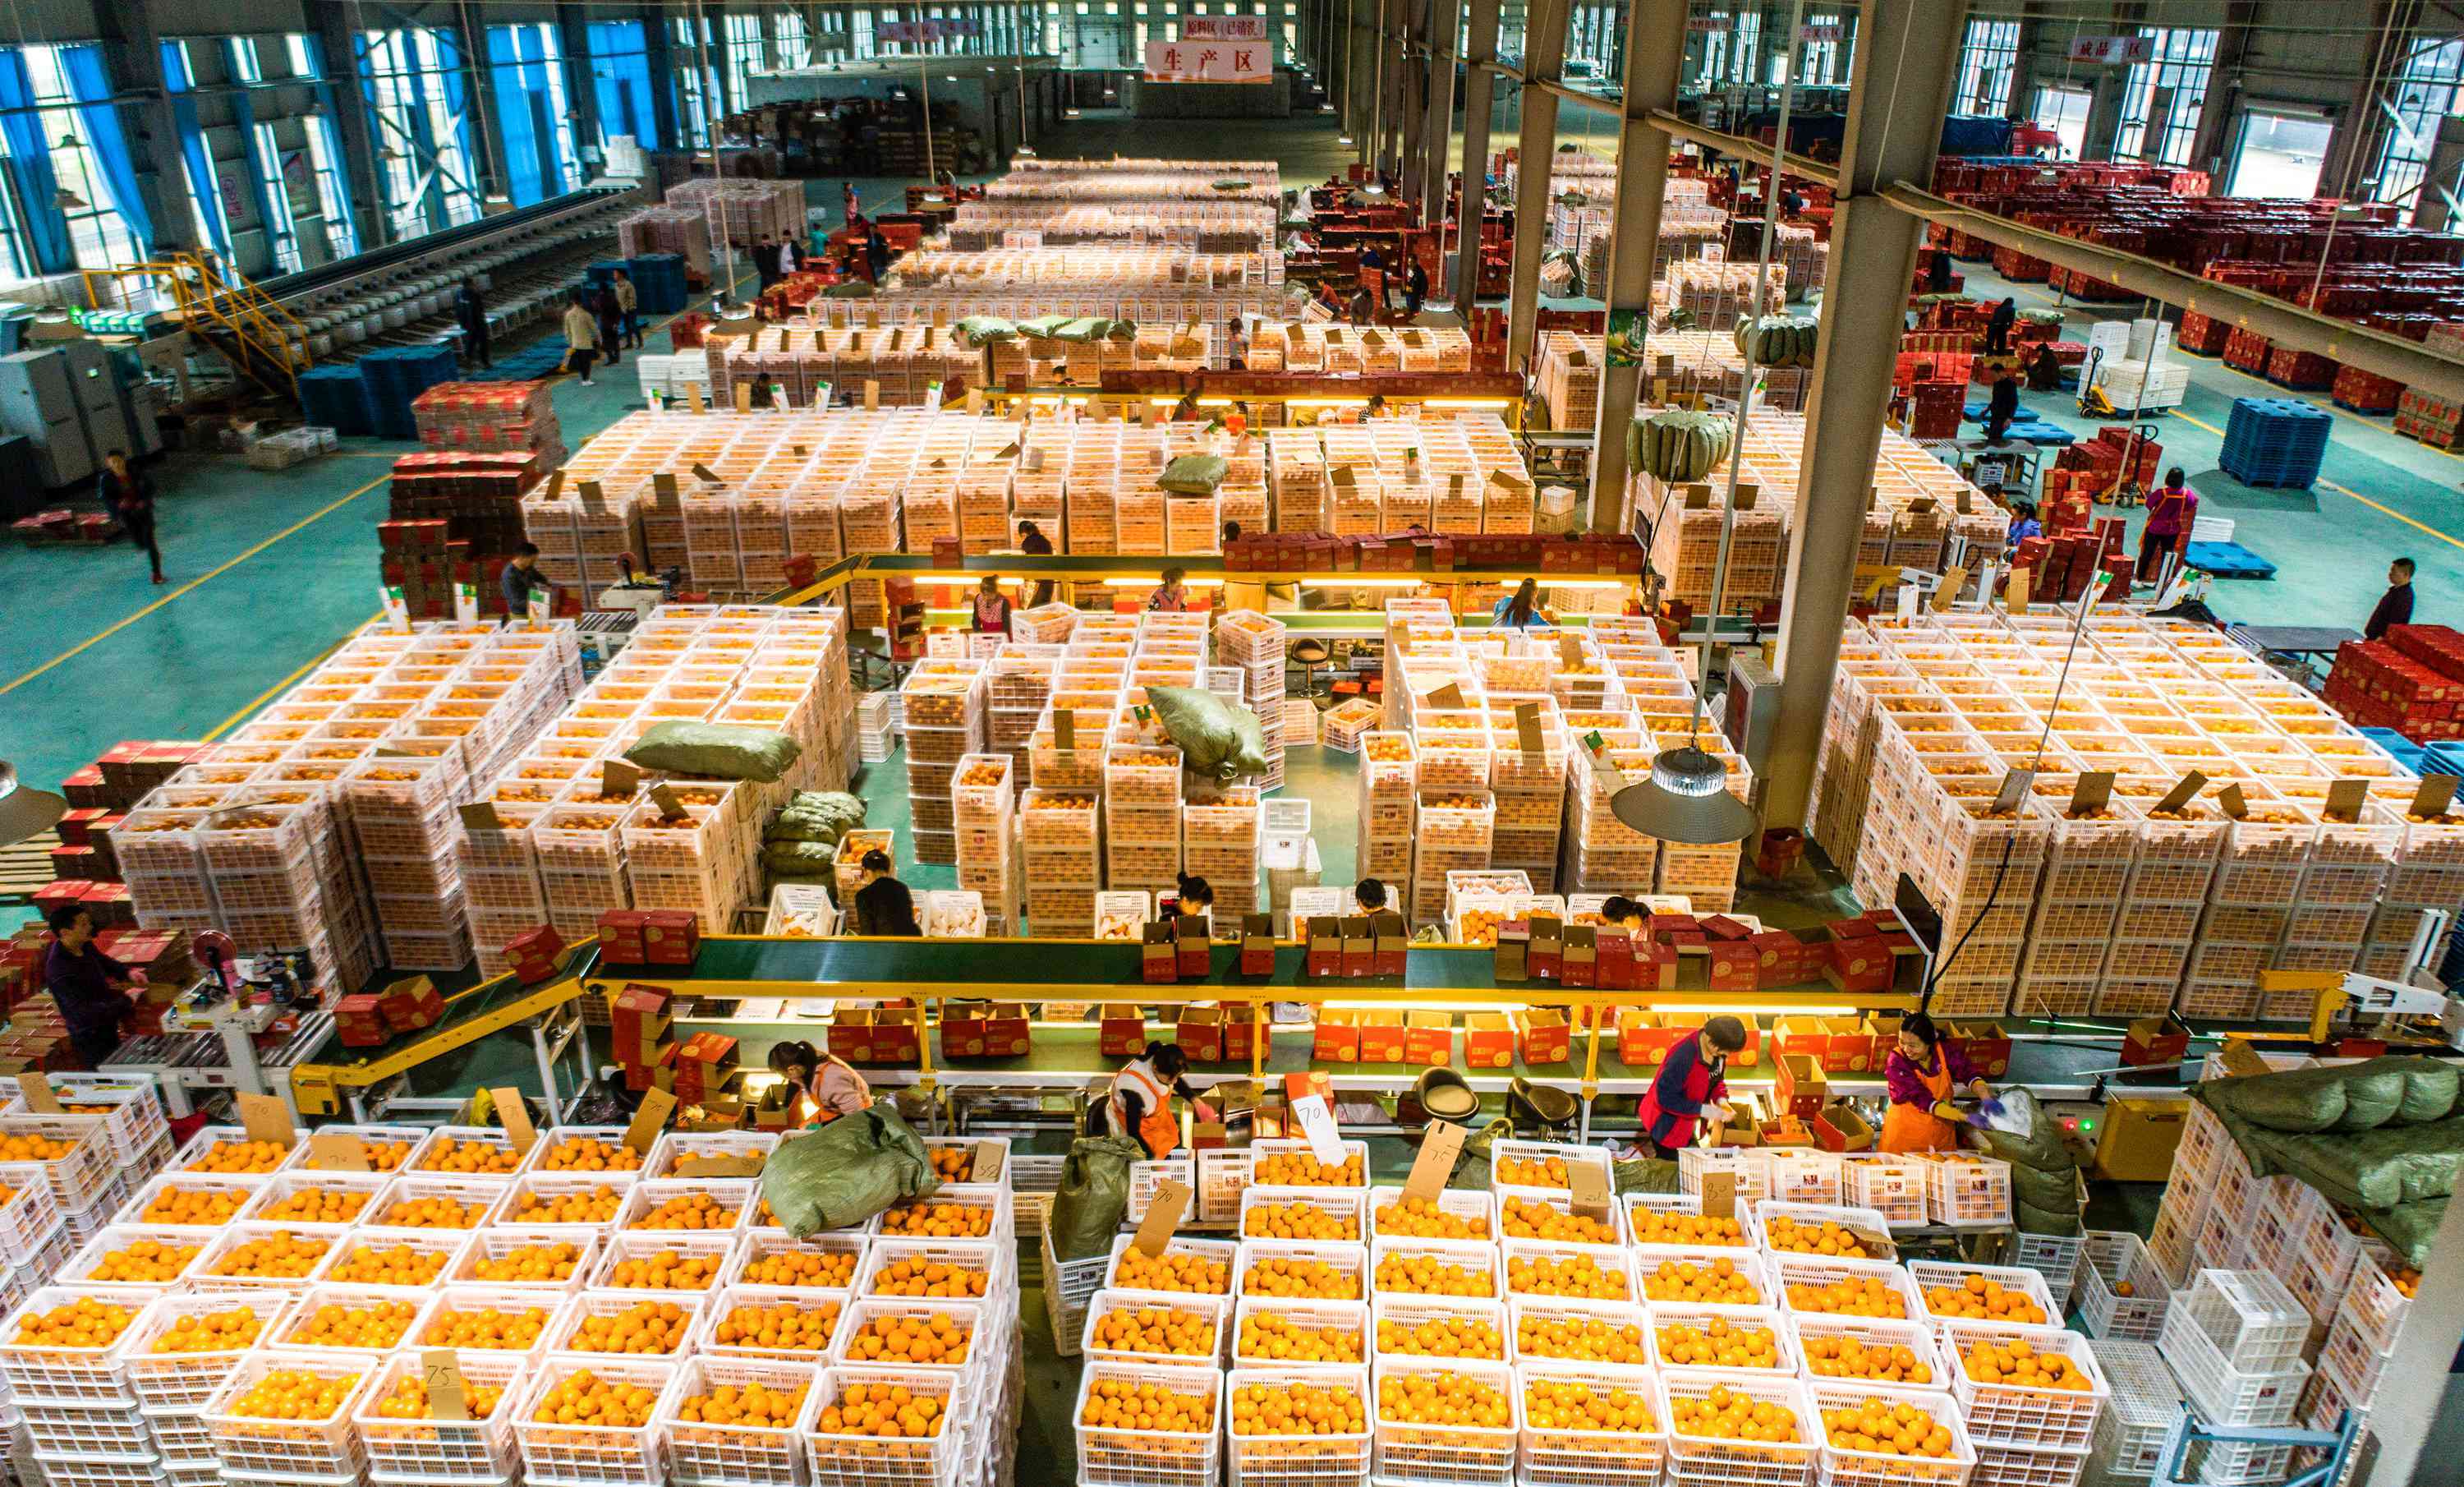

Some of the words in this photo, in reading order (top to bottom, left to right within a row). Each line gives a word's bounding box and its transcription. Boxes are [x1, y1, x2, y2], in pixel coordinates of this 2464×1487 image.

[1163, 48, 1253, 72] 生产区
[1299, 1107, 1321, 1128] 70
[426, 1365, 454, 1386] 75
